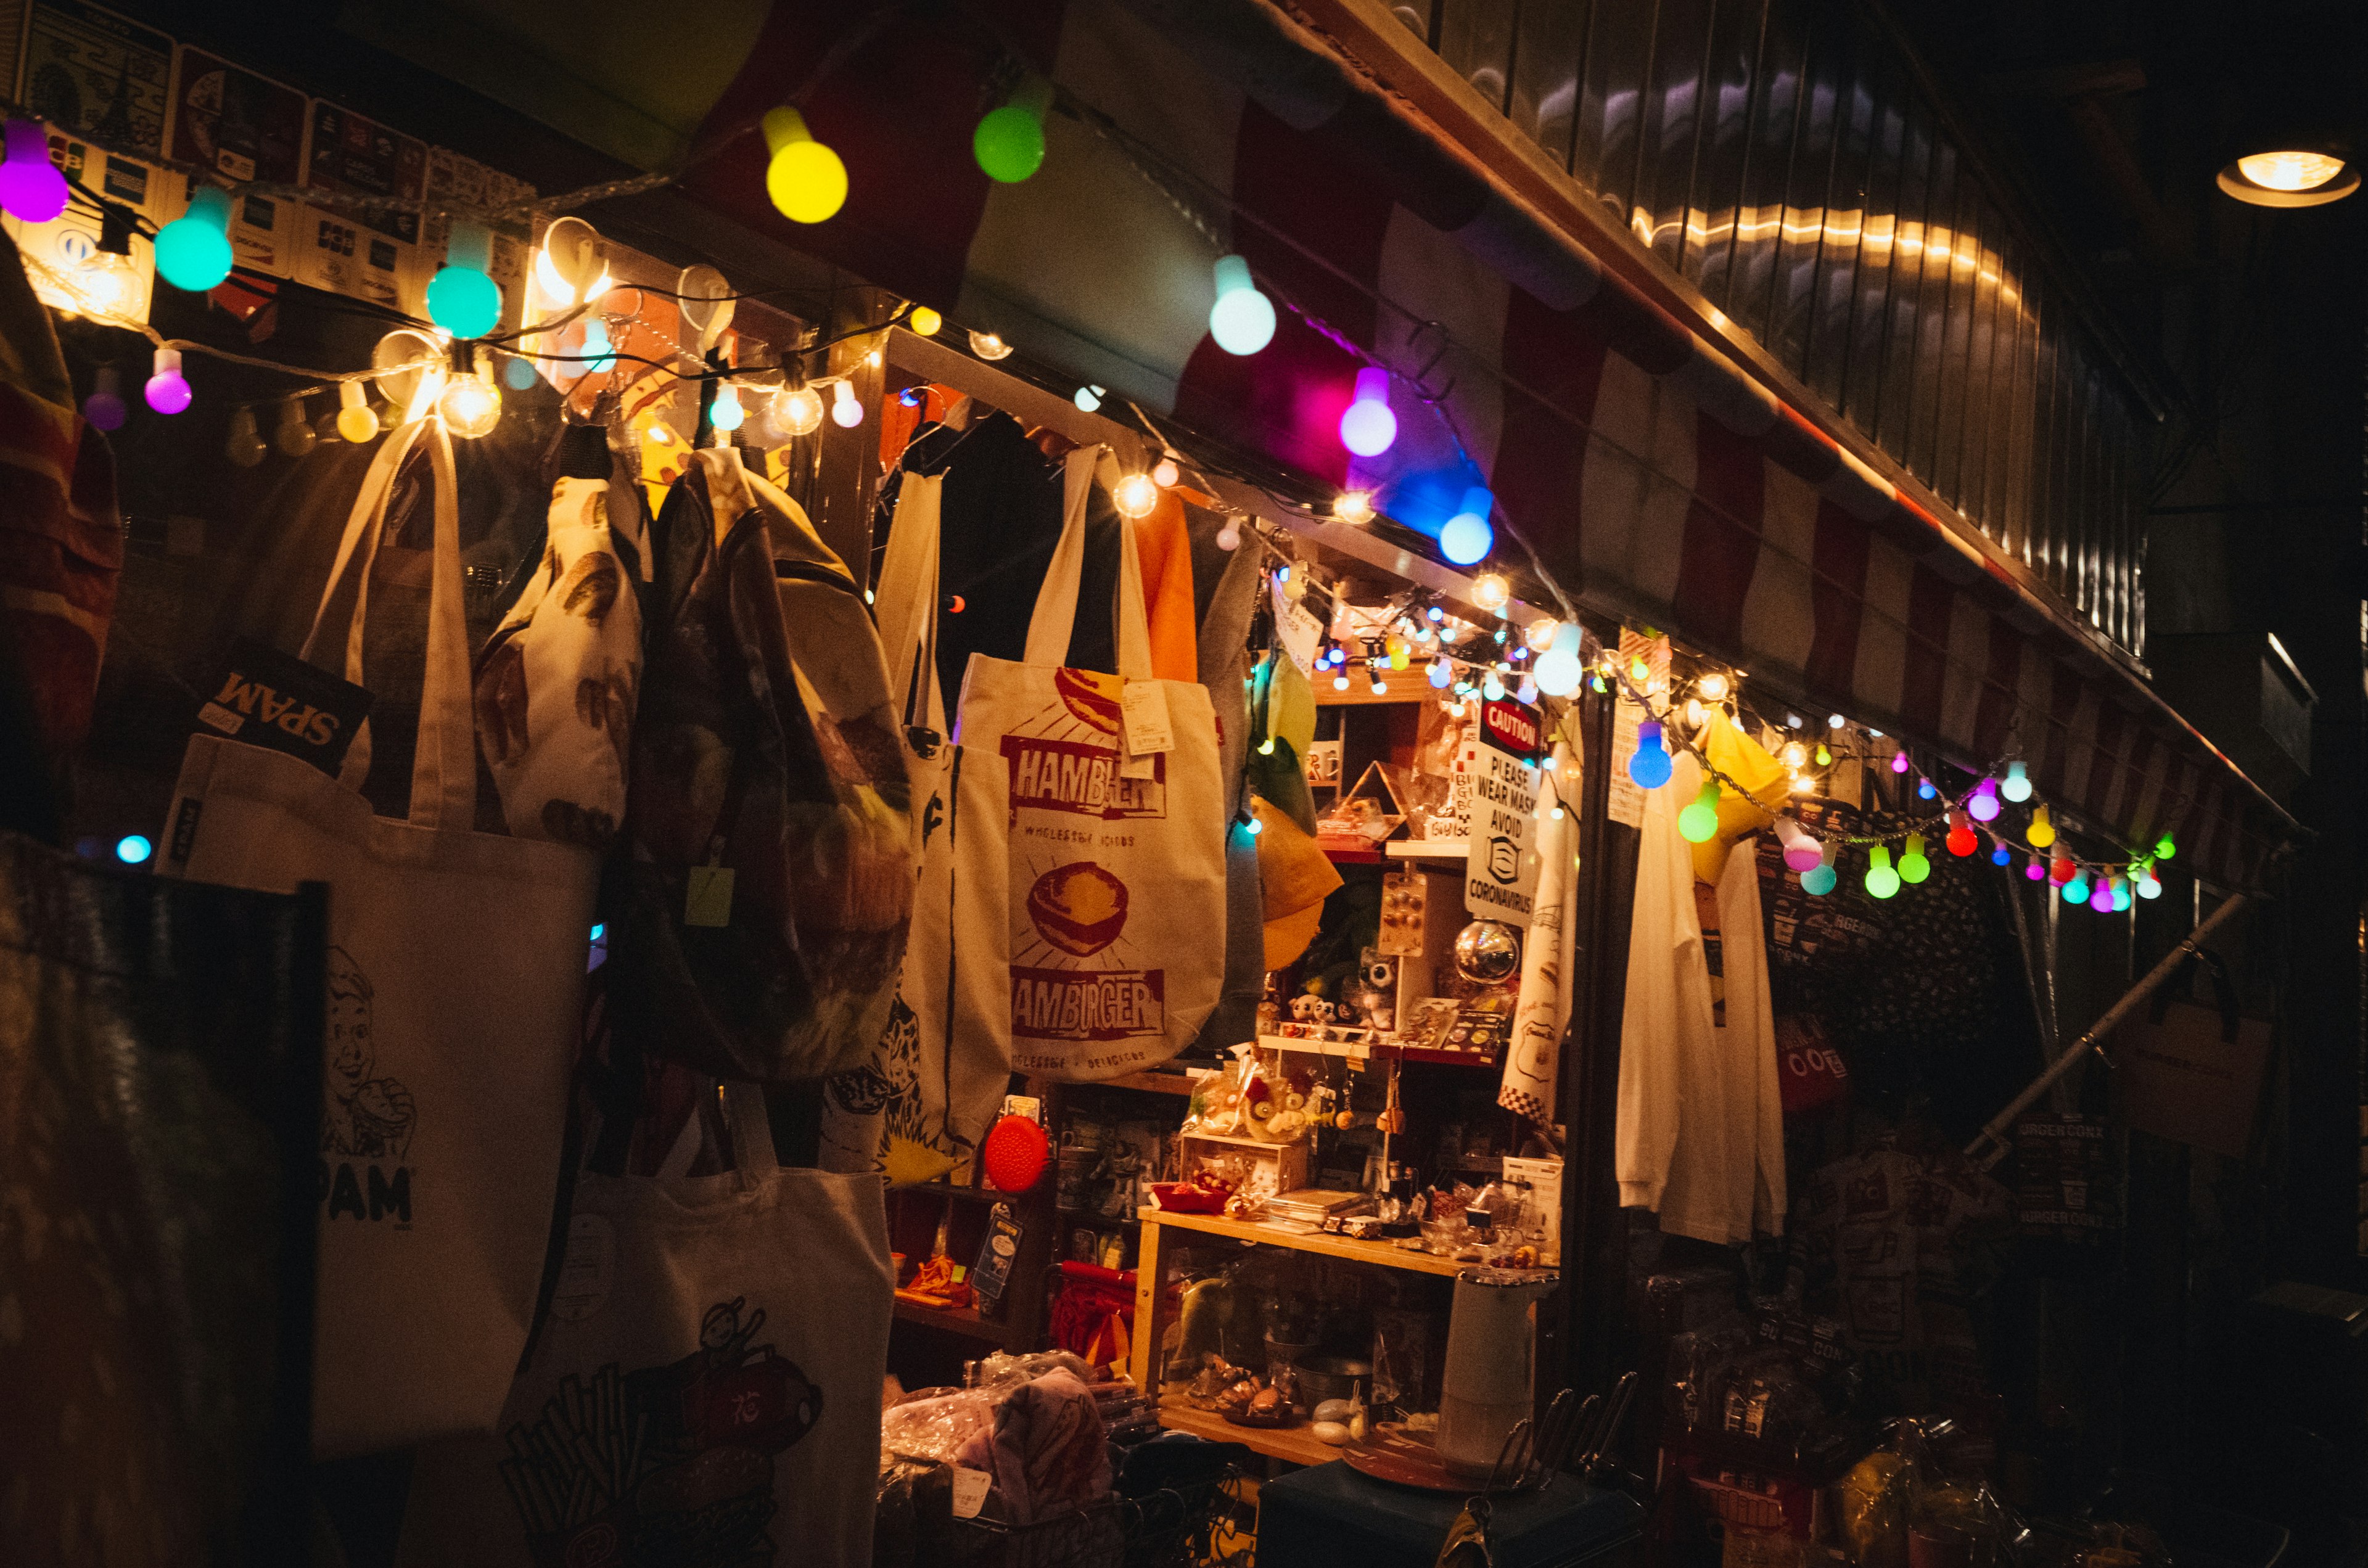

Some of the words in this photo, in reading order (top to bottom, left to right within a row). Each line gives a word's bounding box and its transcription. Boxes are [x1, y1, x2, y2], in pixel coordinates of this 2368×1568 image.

[215, 671, 340, 745] SPAM
[1488, 706, 1536, 746] CAUTION
[1478, 775, 1508, 806] WEAR
[1491, 756, 1528, 791] PLEASE
[1490, 809, 1523, 839] AVOID
[1471, 878, 1531, 914] CORONAVIRUS
[1012, 978, 1150, 1032] AMBURGER
[2020, 1123, 2065, 1136] URGER
[316, 1162, 411, 1222] PAM
